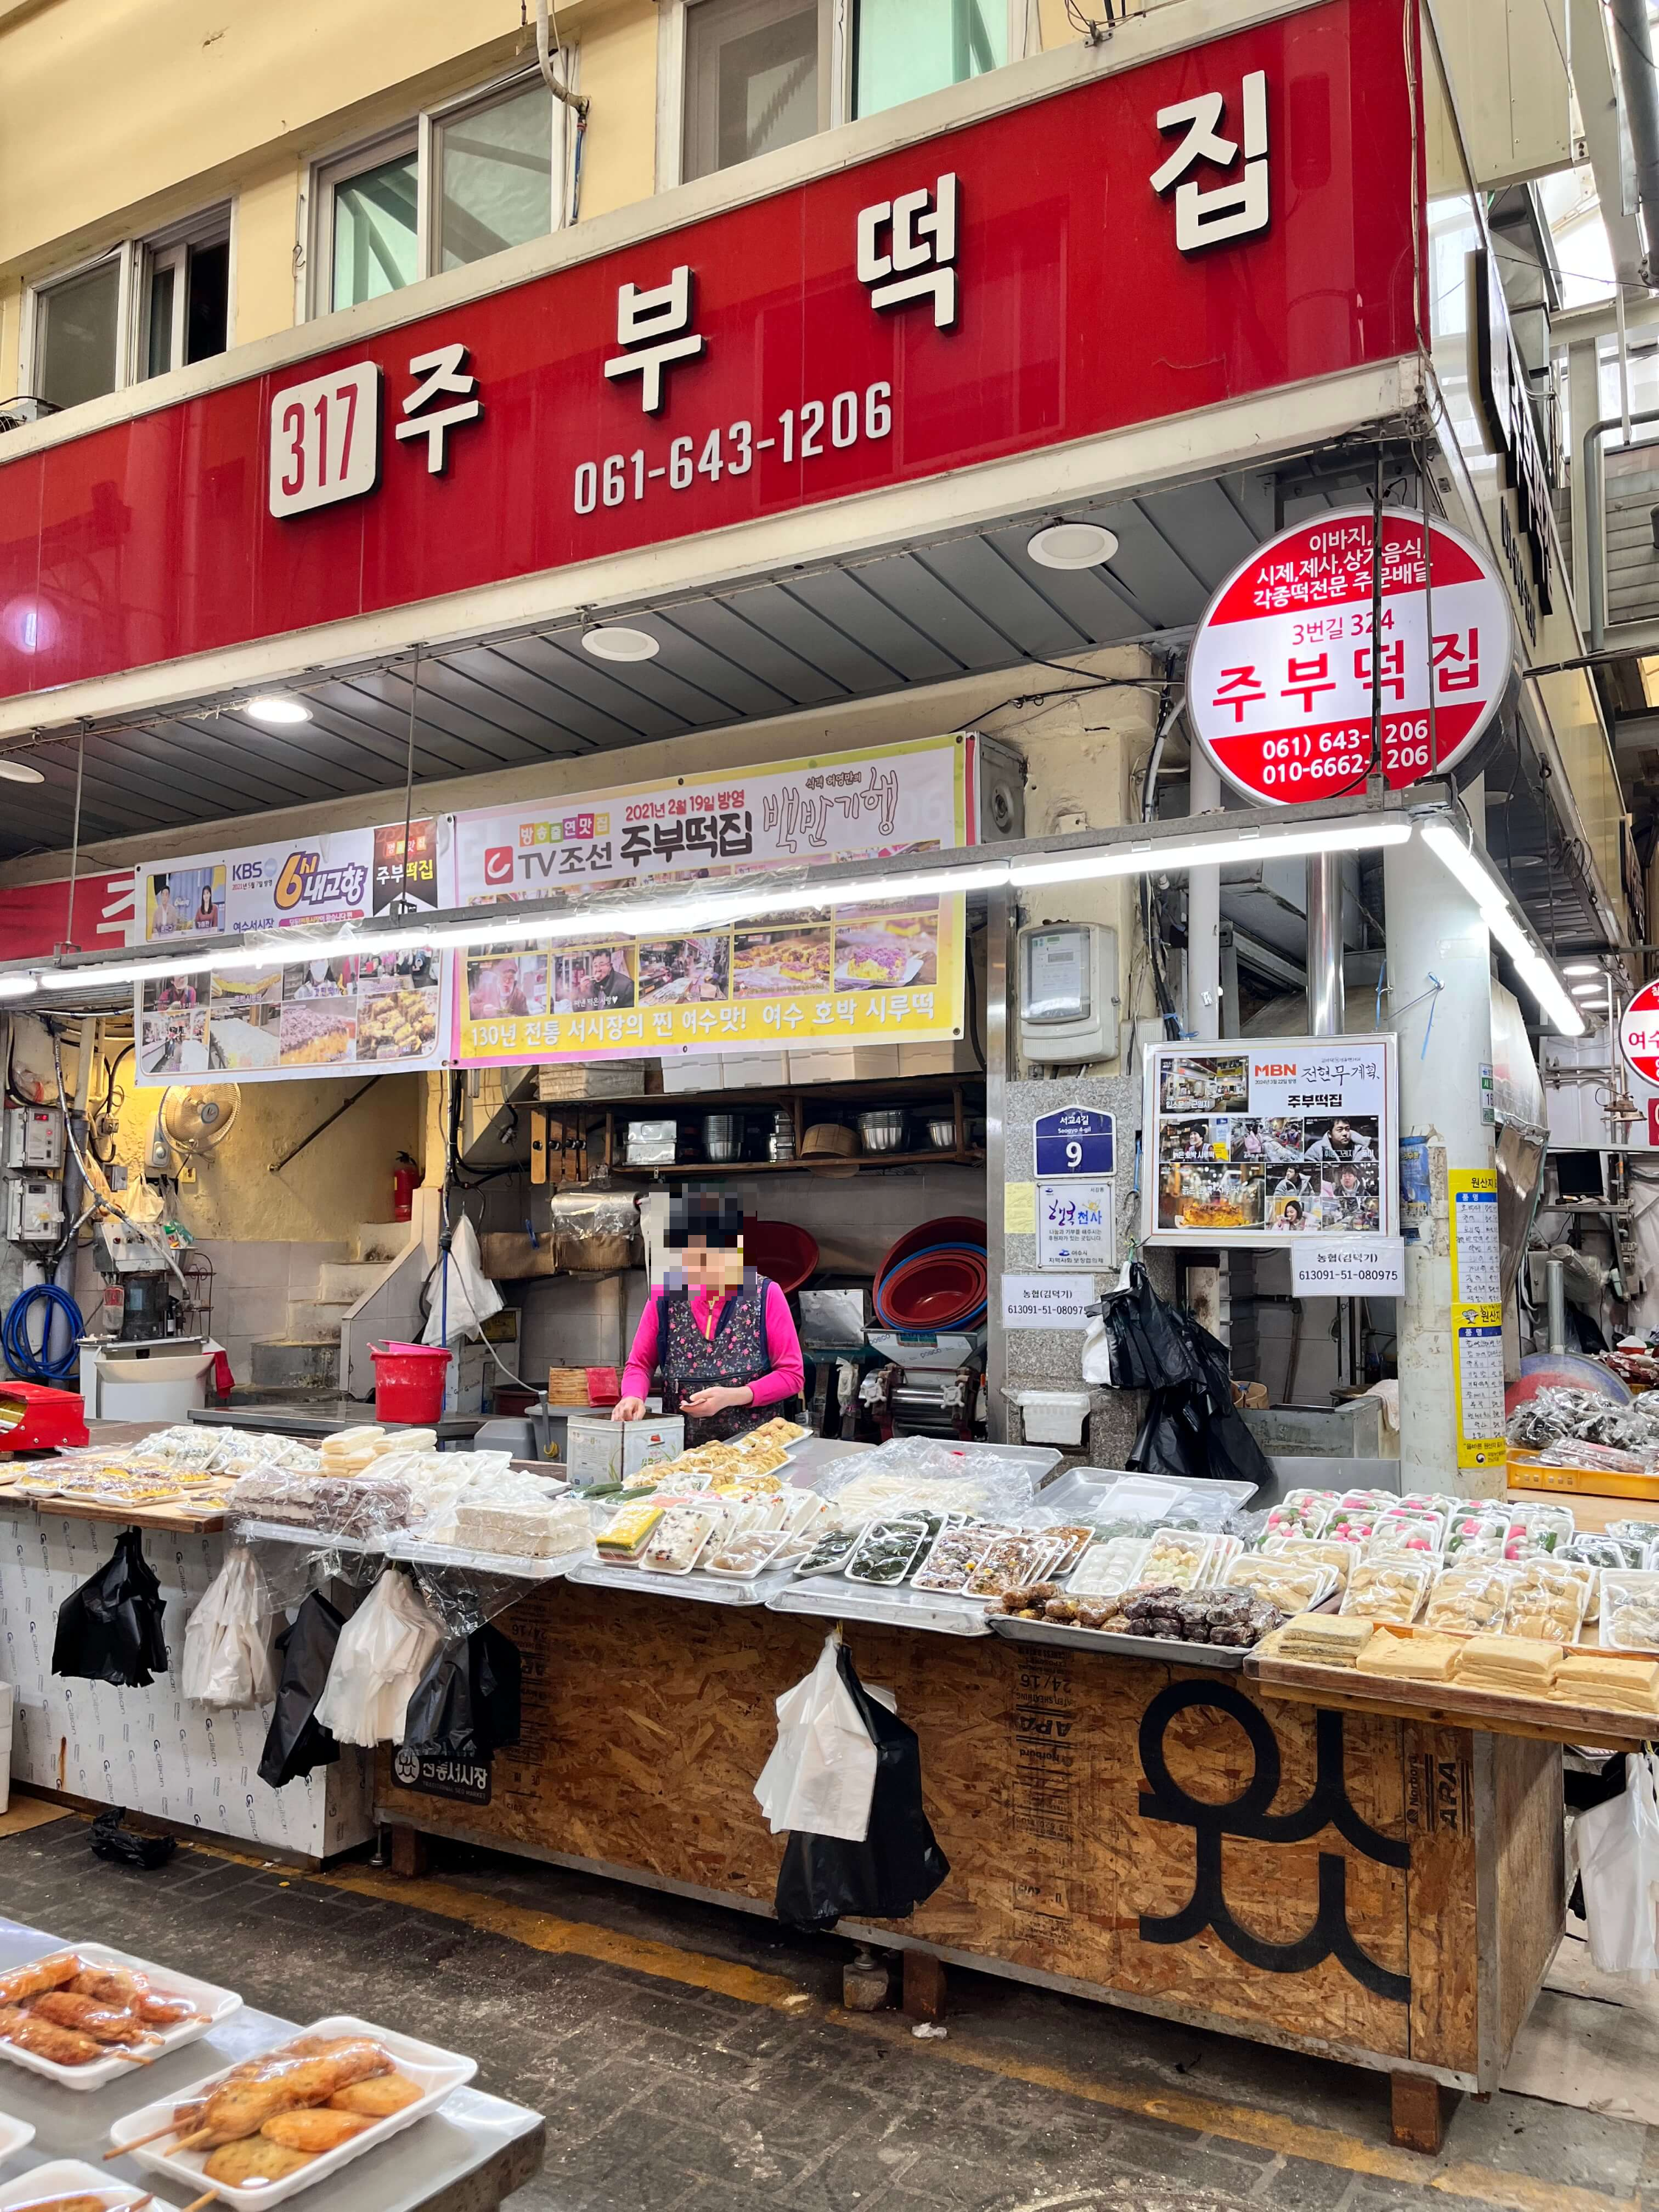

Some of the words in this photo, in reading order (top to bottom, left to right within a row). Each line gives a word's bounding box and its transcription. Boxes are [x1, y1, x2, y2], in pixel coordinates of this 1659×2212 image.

[282, 384, 358, 496] 317
[574, 381, 892, 515] 061-643-1206
[1310, 526, 1373, 552] 이바지,
[1253, 581, 1349, 610] 각종떡전문
[1293, 618, 1343, 645] 3번길
[1263, 734, 1311, 760] 061)
[1319, 720, 1428, 753] 643-206
[826, 771, 861, 787] 허영만의
[1263, 745, 1429, 785] 010-6662-206
[625, 801, 666, 822] 2021년
[668, 799, 686, 815] 2월
[689, 795, 714, 812] 19일
[717, 789, 745, 809] 방영
[763, 767, 898, 853] 백반기행
[518, 841, 612, 879] TV조선
[620, 811, 753, 868] 주부떡집
[232, 861, 262, 881] KBS
[303, 866, 365, 902] 내고향
[376, 860, 434, 885] 주부떡집
[473, 1023, 517, 1048] 130년
[524, 1020, 560, 1046] 전통
[568, 1013, 644, 1043] 서시장의
[653, 1011, 672, 1036] 찐
[682, 1007, 746, 1034] 여수맛!
[762, 1003, 805, 1031] 여수
[812, 998, 858, 1026] 호박
[866, 992, 935, 1023] 시루떡
[1254, 1064, 1296, 1077] MBN
[1287, 1093, 1343, 1107] 주부떡집
[1057, 1127, 1078, 1135] Seogyo
[1079, 1126, 1091, 1134] 4-gil
[1059, 1114, 1089, 1126] 서교4길
[1065, 1141, 1082, 1168] 9
[1471, 1178, 1493, 1189] 원산지
[1298, 1270, 1398, 1281] 613091-51-080975
[1008, 1304, 1087, 1315] 613091-51-08097
[42, 1545, 50, 1577] Gilsan
[178, 1565, 188, 1599] Gilsan
[32, 1634, 40, 1666] Gilsan
[1021, 1674, 1072, 1693] 24/16
[68, 1702, 77, 1736] Gilsan
[208, 1732, 218, 1767] Gilsan
[156, 1753, 164, 1788] Gilsan
